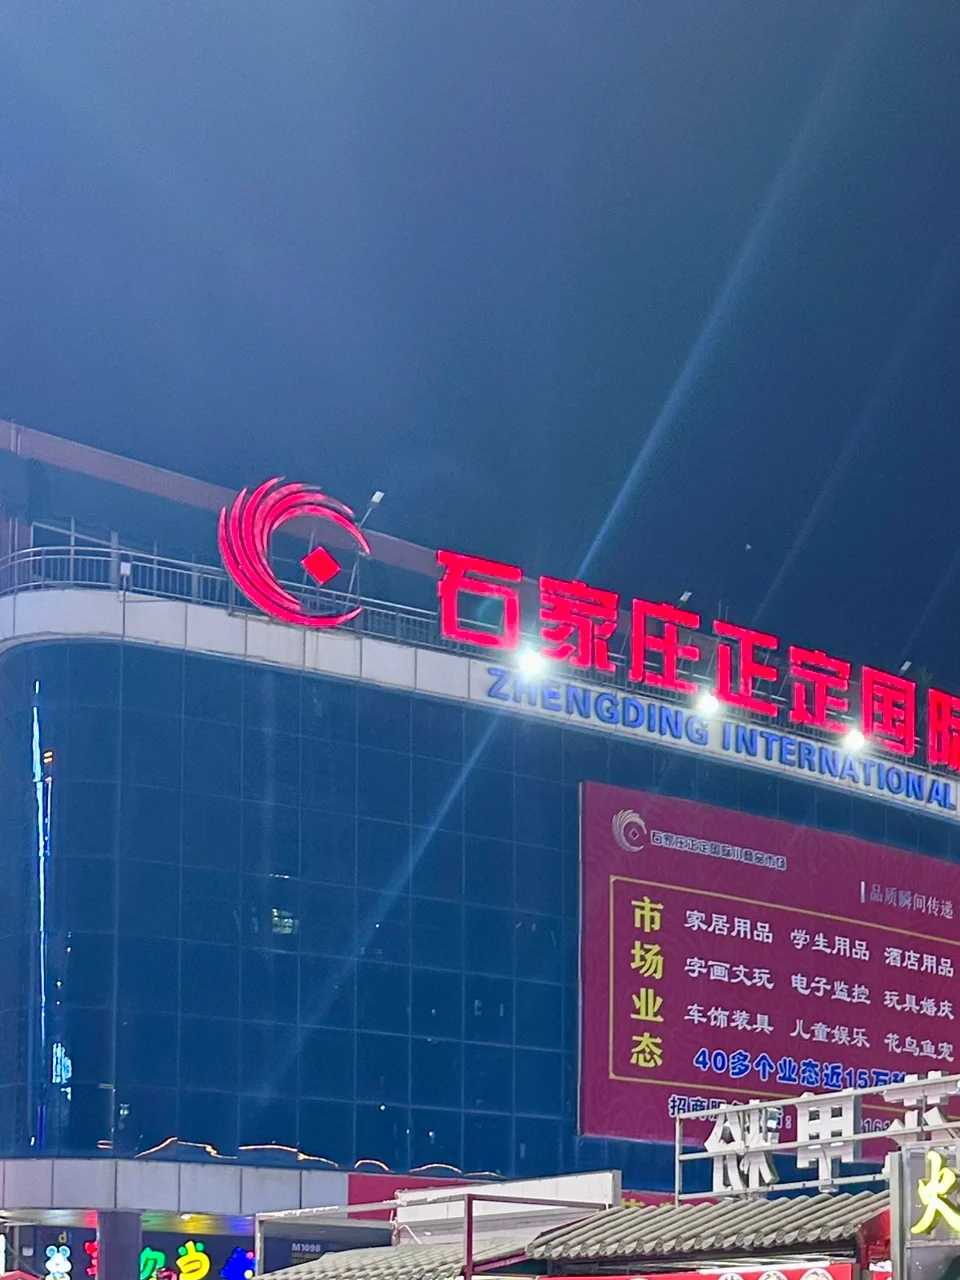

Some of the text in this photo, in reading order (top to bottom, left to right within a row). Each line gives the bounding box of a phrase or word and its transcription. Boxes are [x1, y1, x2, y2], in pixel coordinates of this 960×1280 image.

[487, 667, 709, 746] ZHENGDING
[722, 723, 957, 811] INTERNATIONAL
[651, 830, 787, 870] 石家庄正定国际小商品市场
[684, 909, 774, 944] 家居用品
[790, 928, 870, 961] 学生用品
[884, 946, 954, 978] 酒店用品
[631, 896, 665, 1070] 市场业态
[684, 957, 775, 990] 字画文玩
[790, 973, 871, 1005] 电子监控
[884, 990, 955, 1021] 玩具婚庆
[684, 1003, 955, 1063] 车饰装具 儿童娱乐 花鸟鱼宠
